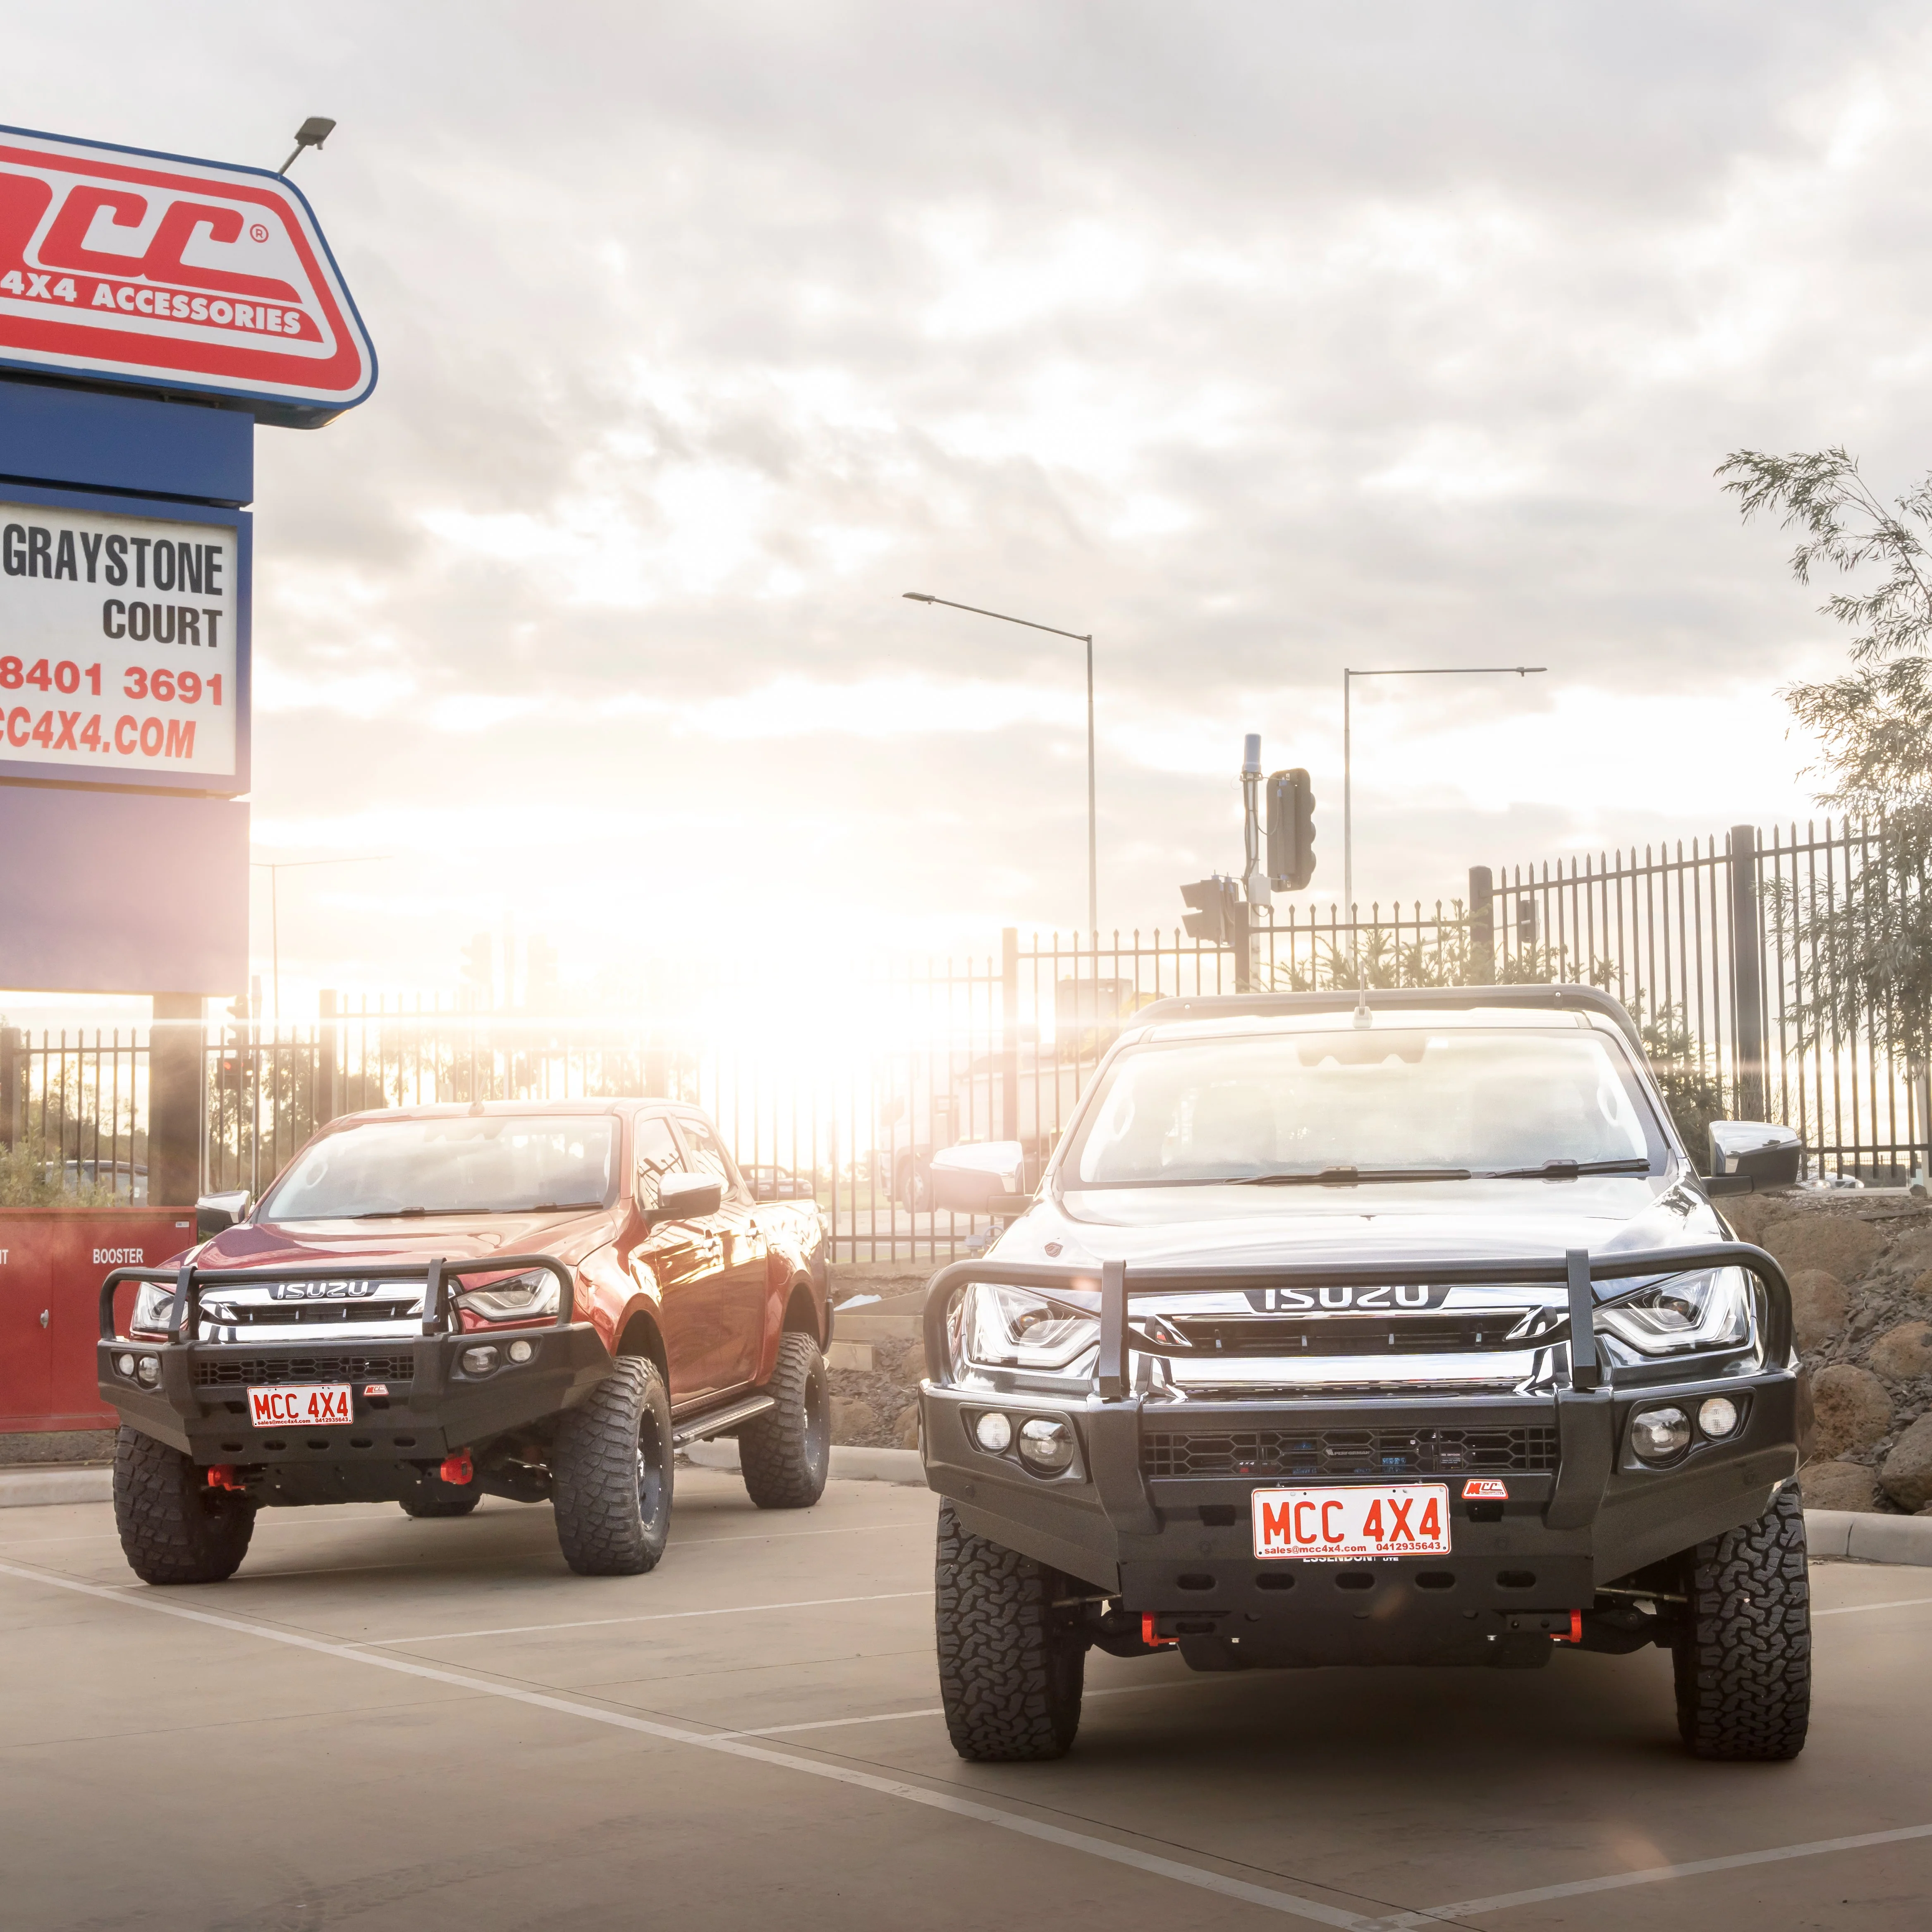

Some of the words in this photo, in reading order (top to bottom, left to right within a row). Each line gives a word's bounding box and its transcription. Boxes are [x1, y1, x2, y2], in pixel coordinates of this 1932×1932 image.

[0, 270, 77, 302] 4X4
[92, 283, 301, 334] ACCESSORIES
[3, 524, 222, 595] GRAYSTONE
[103, 599, 222, 647] COURT
[0, 656, 101, 696] 8401
[124, 667, 222, 705] 3691
[0, 706, 196, 758] C4X4.COM
[93, 1248, 143, 1264] BOOSTER
[277, 1282, 368, 1299] ISUZU
[1265, 1285, 1429, 1310] ISUZU
[253, 1393, 299, 1420] MCC
[308, 1392, 348, 1418] 4X4
[1262, 1501, 1344, 1545] MCC
[1363, 1497, 1441, 1542] 4X4
[1265, 1544, 1367, 1554] sales@mcc4x4.com
[1376, 1542, 1441, 1551] 0412935643
